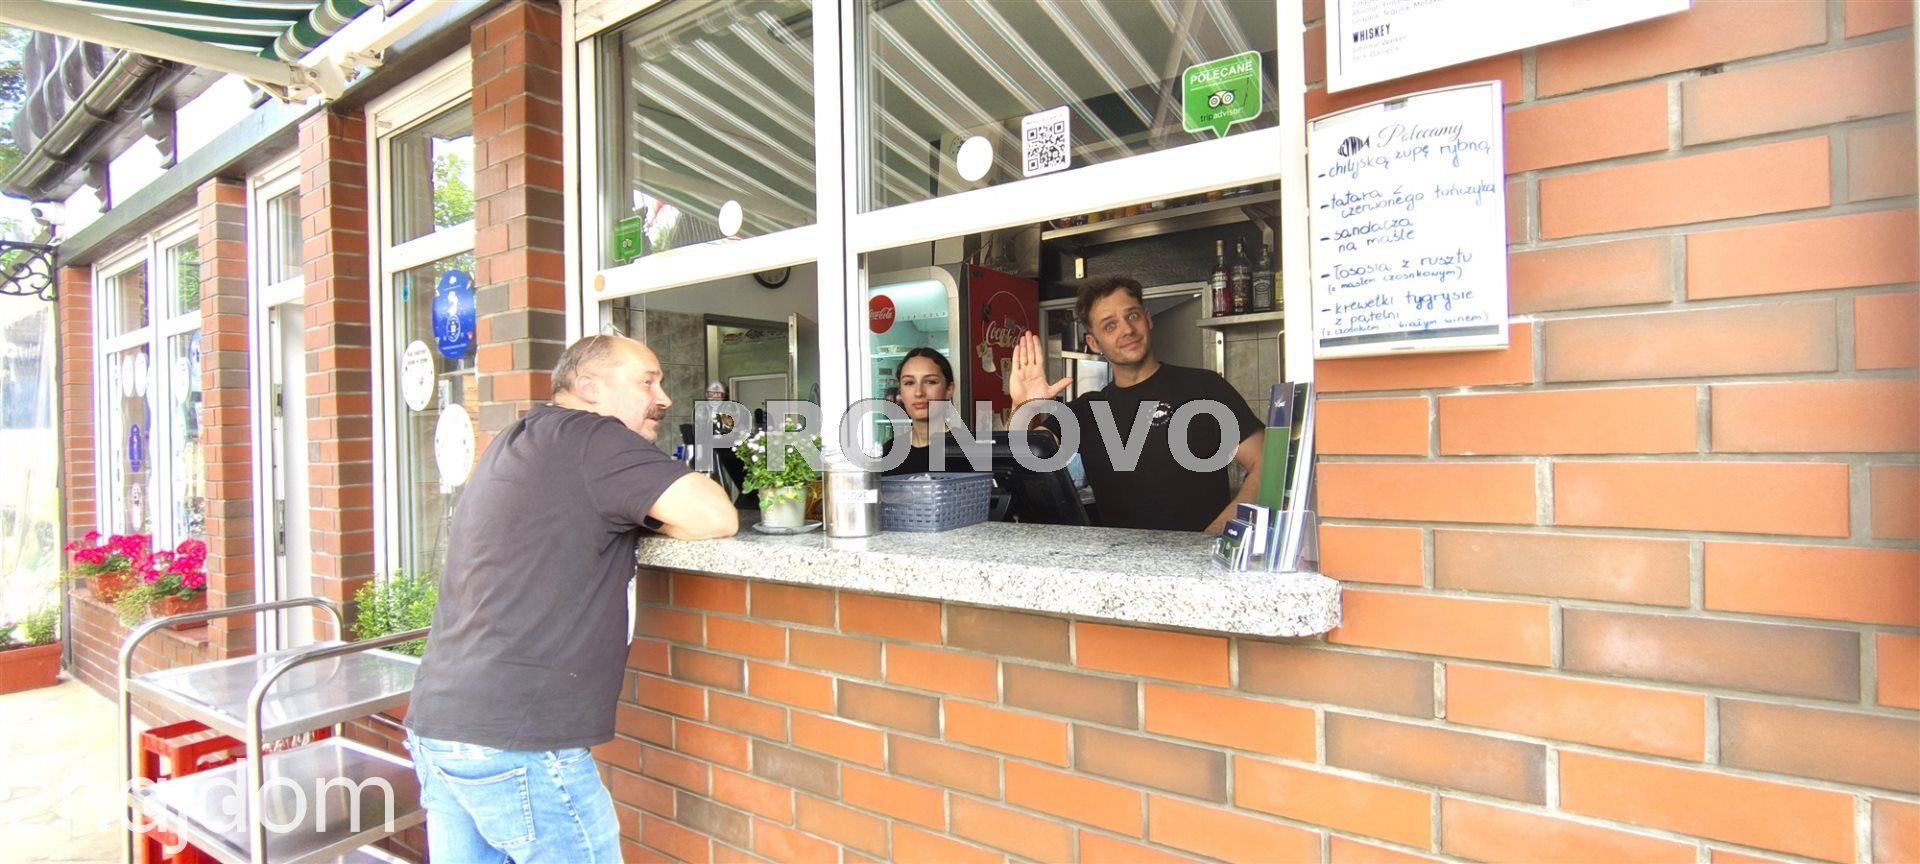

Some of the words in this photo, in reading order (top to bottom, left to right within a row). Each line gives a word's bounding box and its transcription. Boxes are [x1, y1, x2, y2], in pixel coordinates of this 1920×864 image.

[1352, 23, 1391, 43] WHISKEY
[1190, 60, 1254, 86] POLECANE
[1200, 106, 1245, 123] tripadvisor
[1377, 122, 1463, 148] Polecamy
[1338, 241, 1357, 253] na
[1401, 259, 1410, 268] z
[1420, 248, 1473, 266] rusztu
[1335, 315, 1343, 326] z
